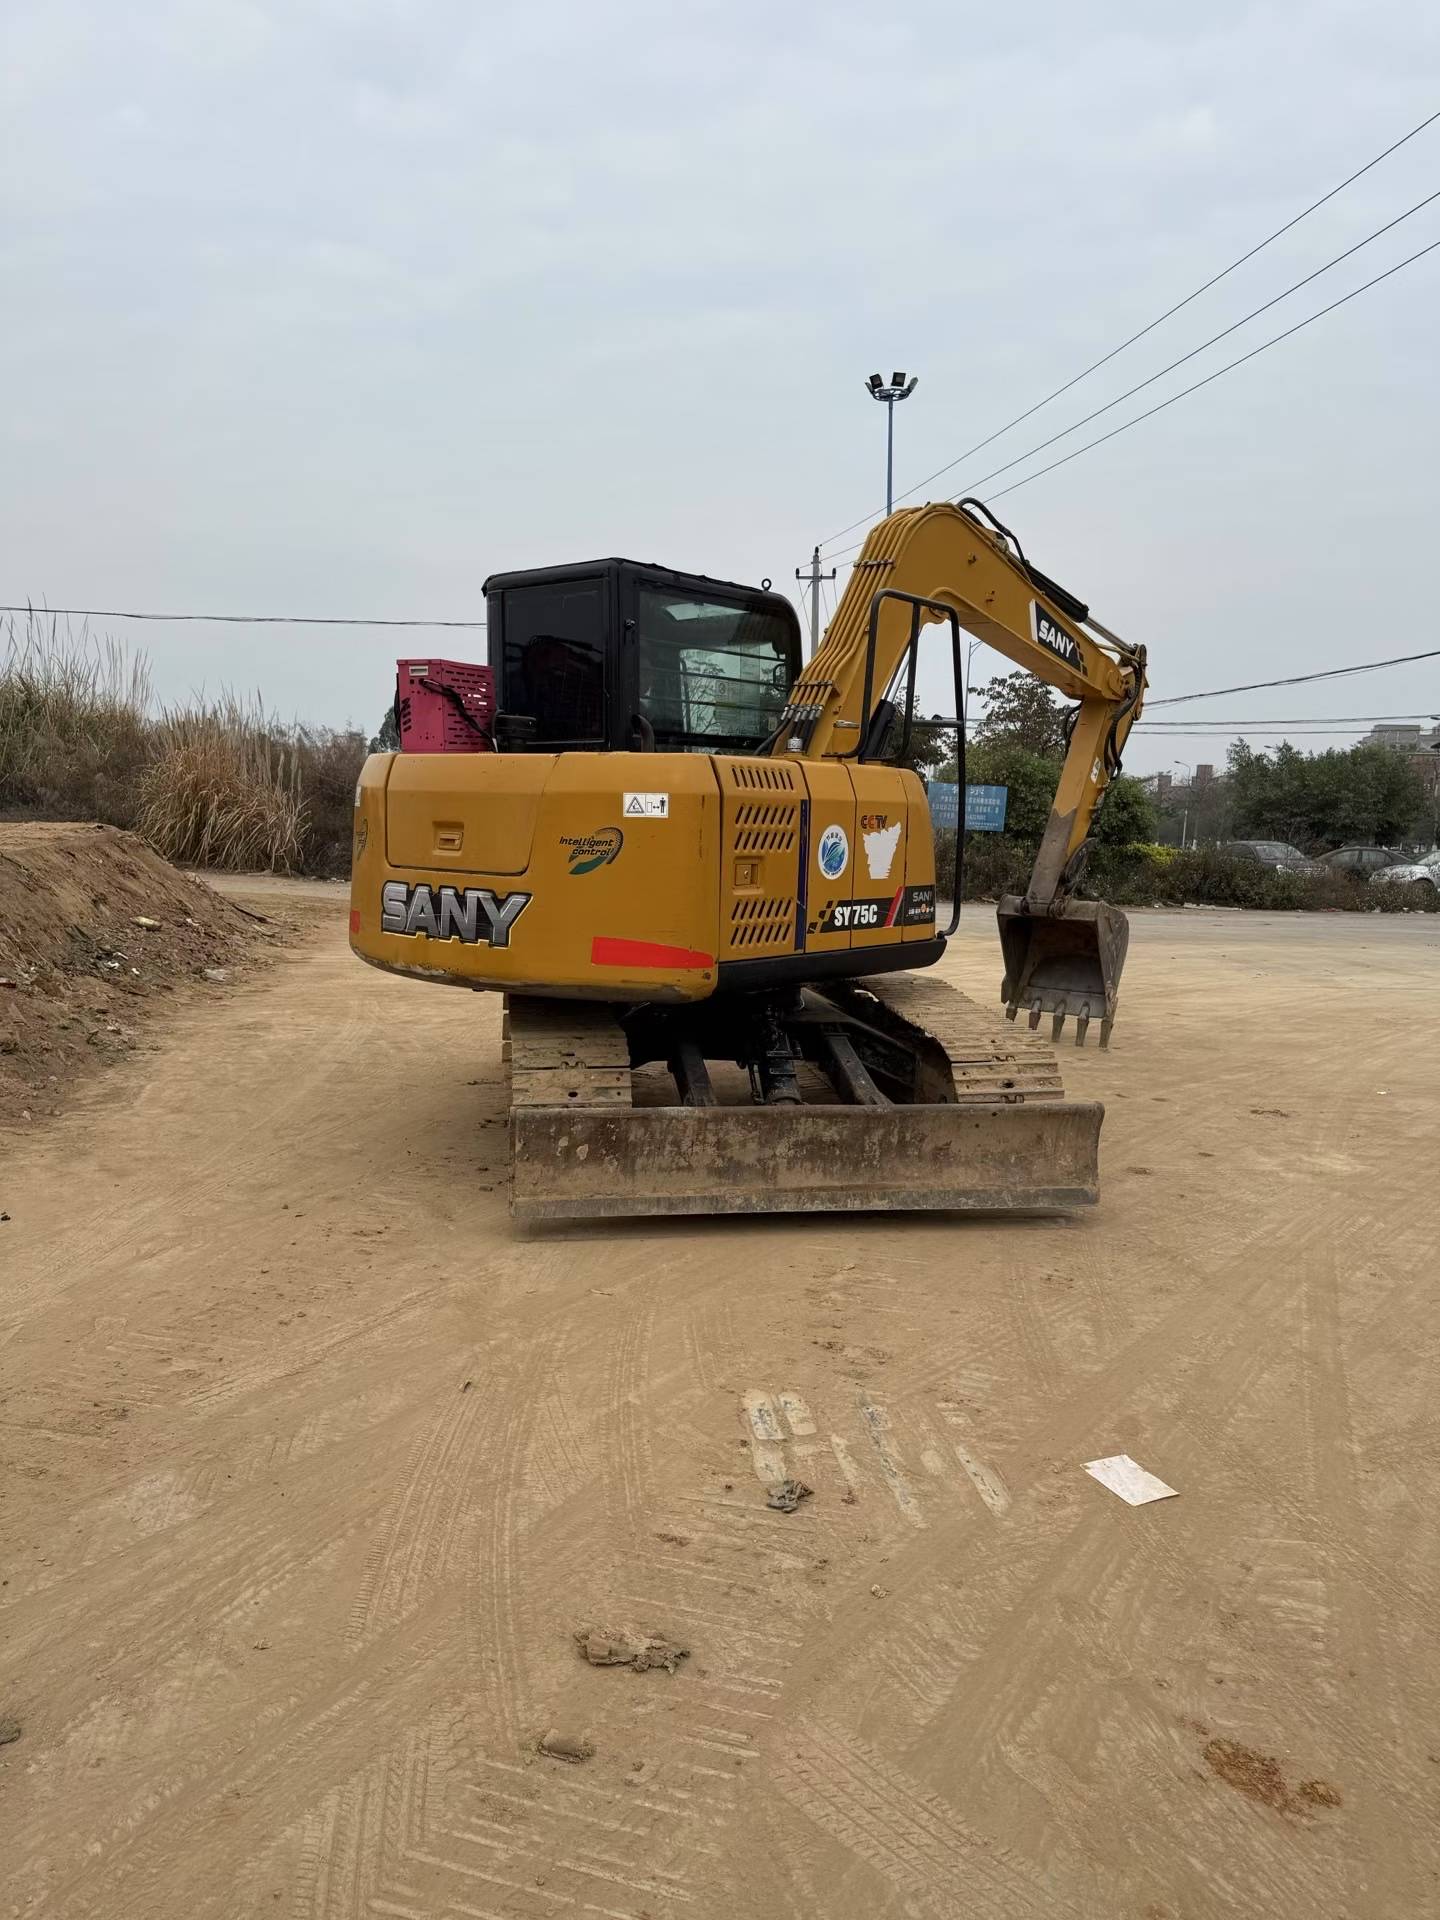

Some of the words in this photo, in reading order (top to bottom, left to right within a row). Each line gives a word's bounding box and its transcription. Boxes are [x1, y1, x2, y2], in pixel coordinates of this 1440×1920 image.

[1038, 619, 1074, 658] SANY
[861, 815, 888, 829] CCTV
[382, 881, 532, 949] SANY
